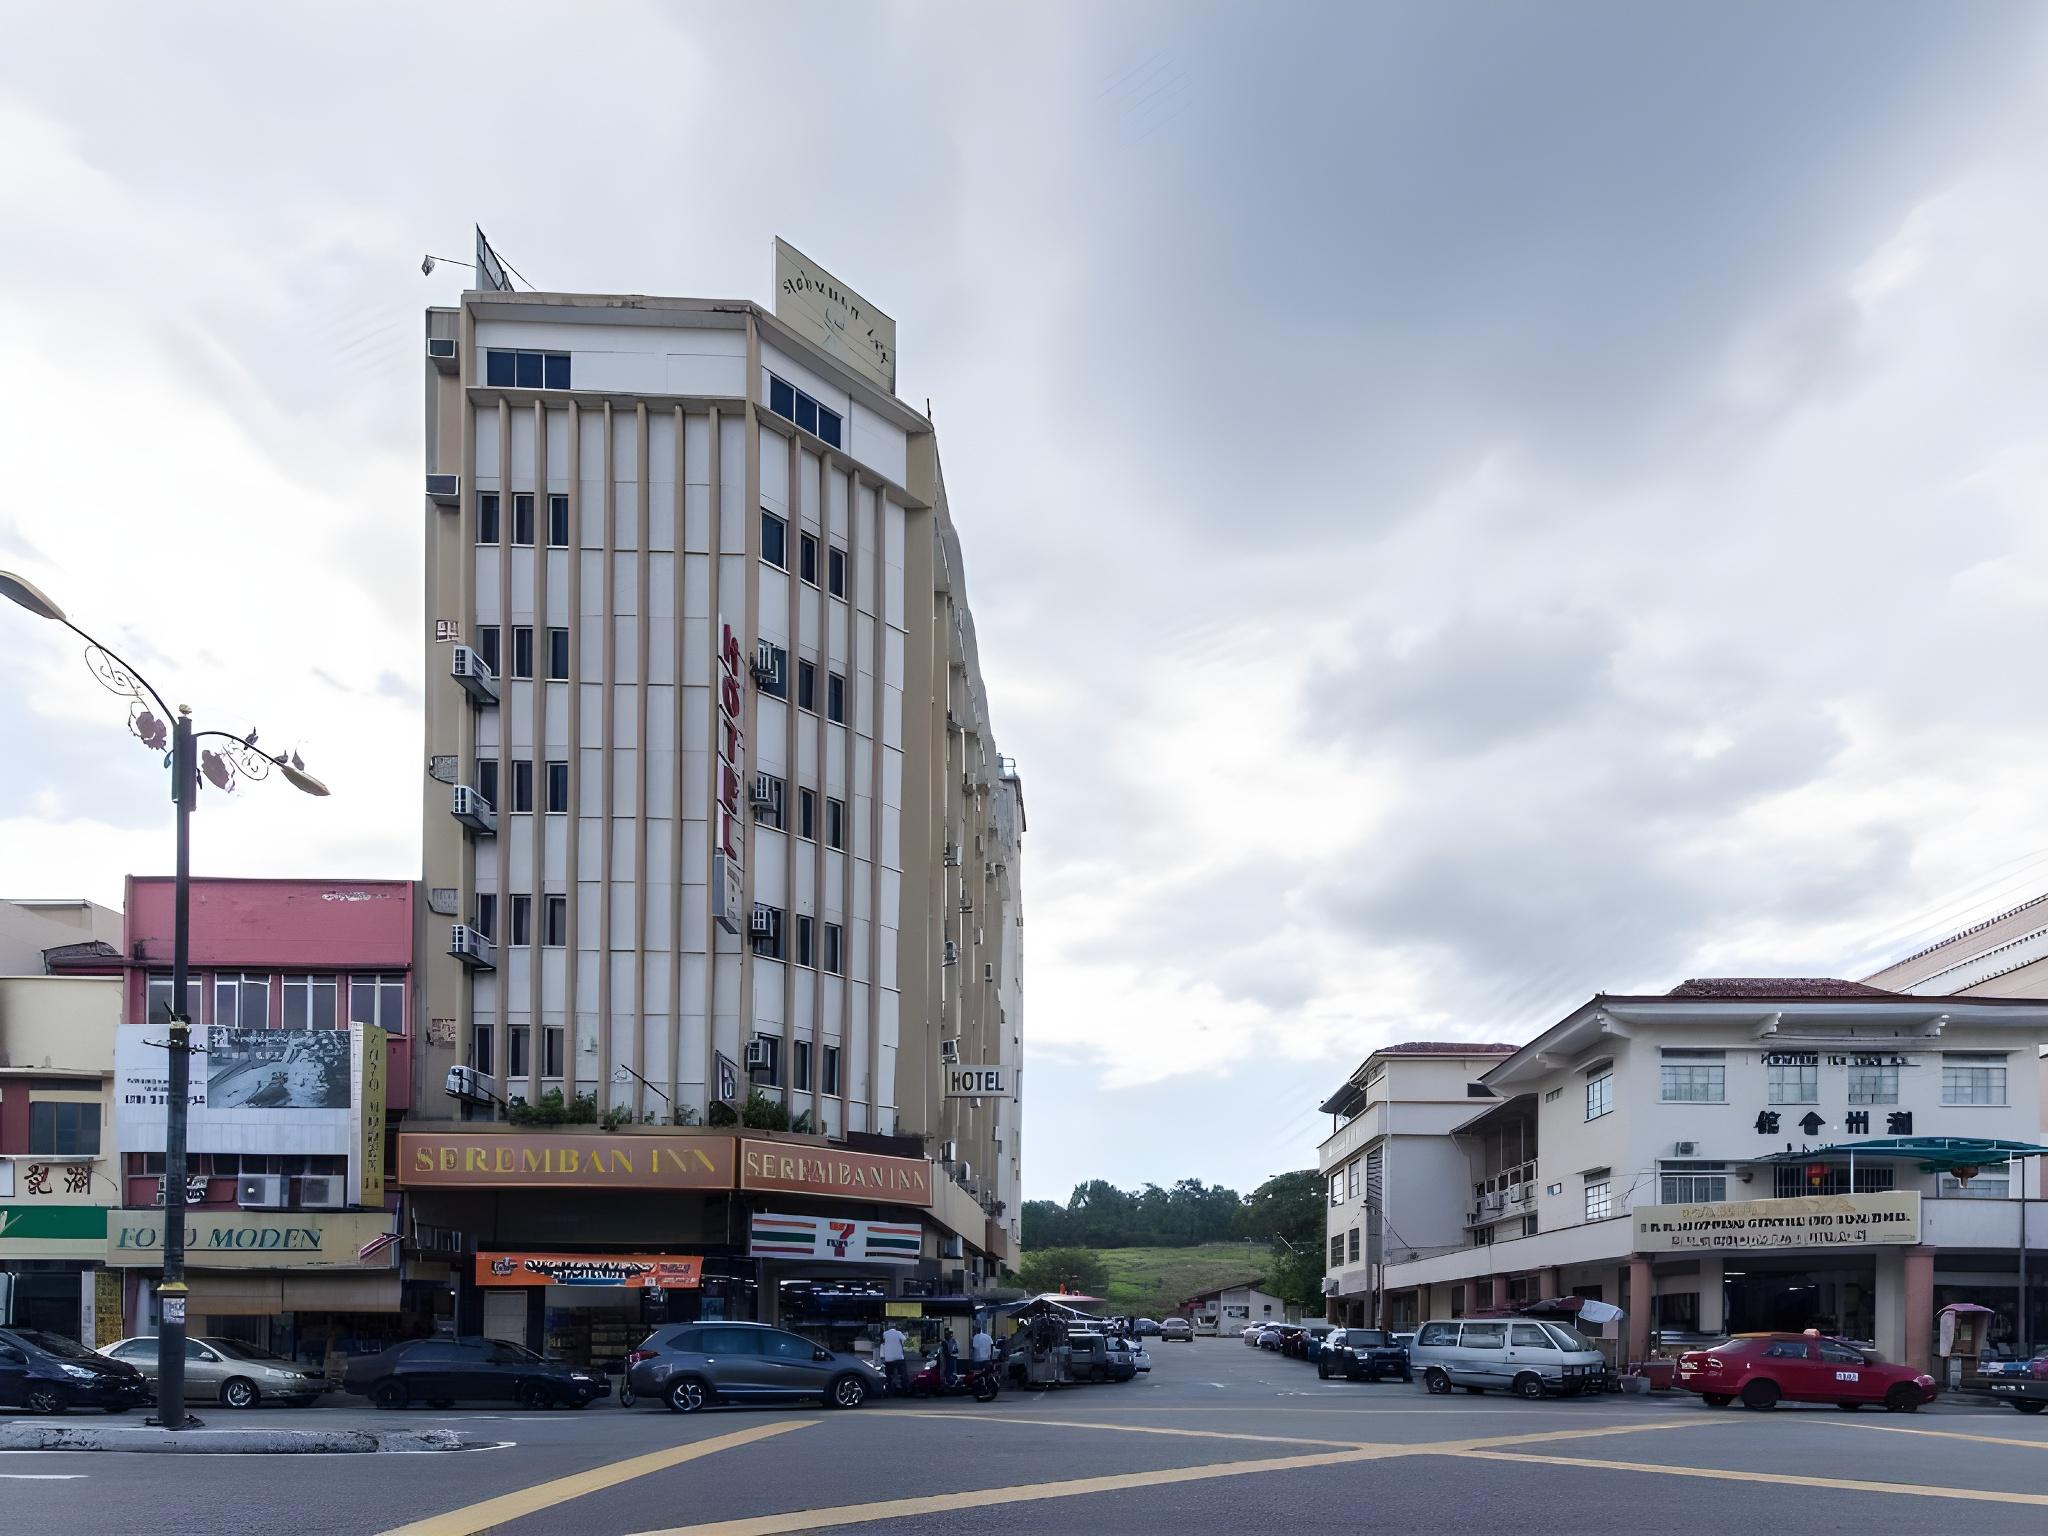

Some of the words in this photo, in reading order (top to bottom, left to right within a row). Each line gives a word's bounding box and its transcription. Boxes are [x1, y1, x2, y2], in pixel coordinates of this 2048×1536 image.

[721, 623, 741, 862] HOTEL
[951, 1071, 1005, 1092] HOTEL
[415, 1147, 634, 1174] SEREMBAN
[208, 1227, 323, 1249] MODEN
